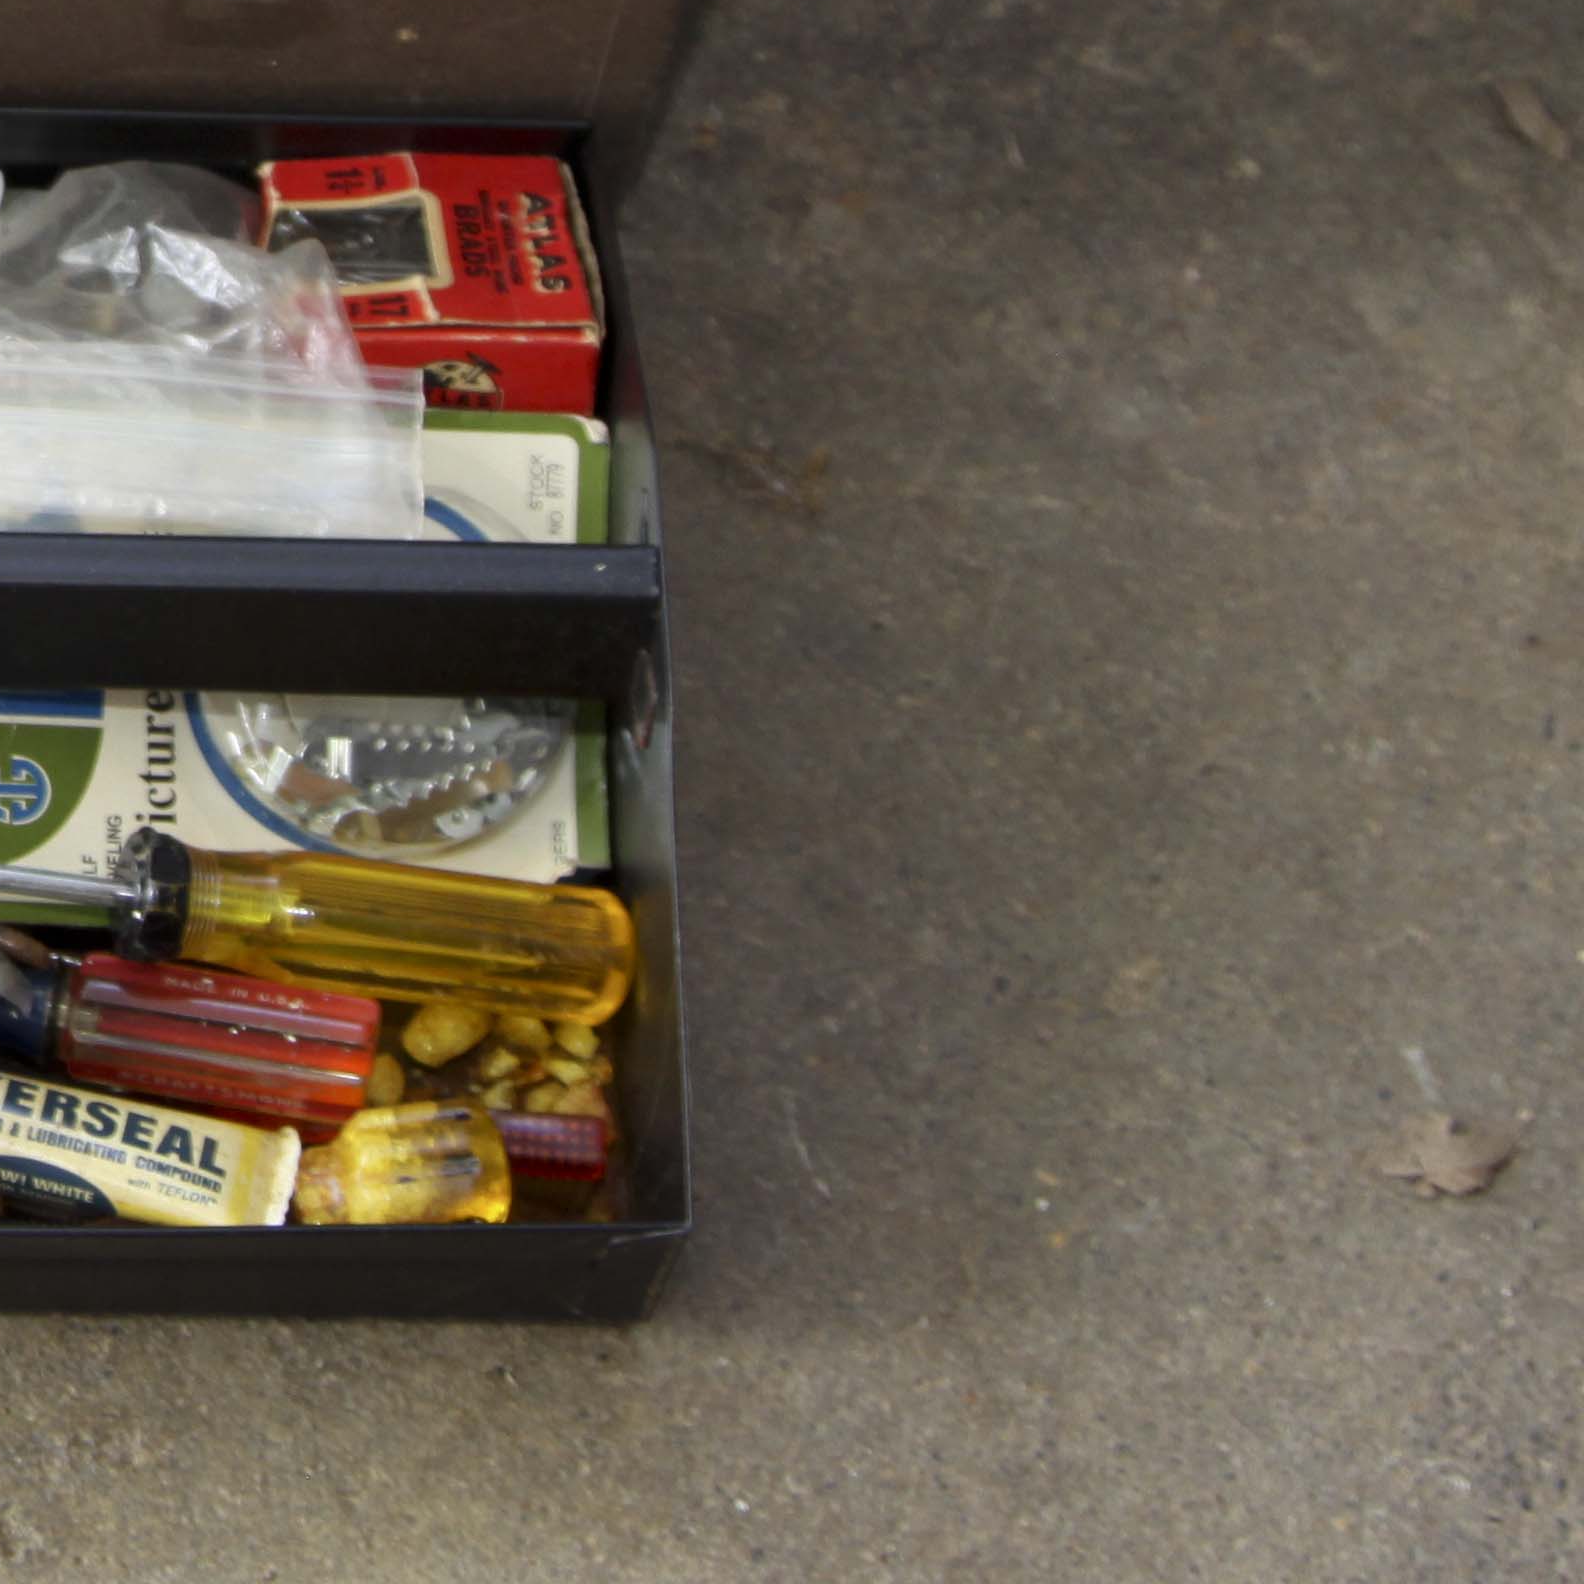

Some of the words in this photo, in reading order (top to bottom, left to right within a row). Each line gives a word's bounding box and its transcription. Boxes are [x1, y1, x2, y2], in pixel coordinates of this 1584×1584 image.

[453, 202, 483, 278] BRADS
[519, 192, 572, 293] ATLAS
[136, 689, 177, 826] icture
[9, 1122, 20, 1138] &
[26, 1128, 128, 1165] LUBRICATING
[134, 1156, 224, 1194] COMPOUND
[32, 1174, 96, 1205] WHITE
